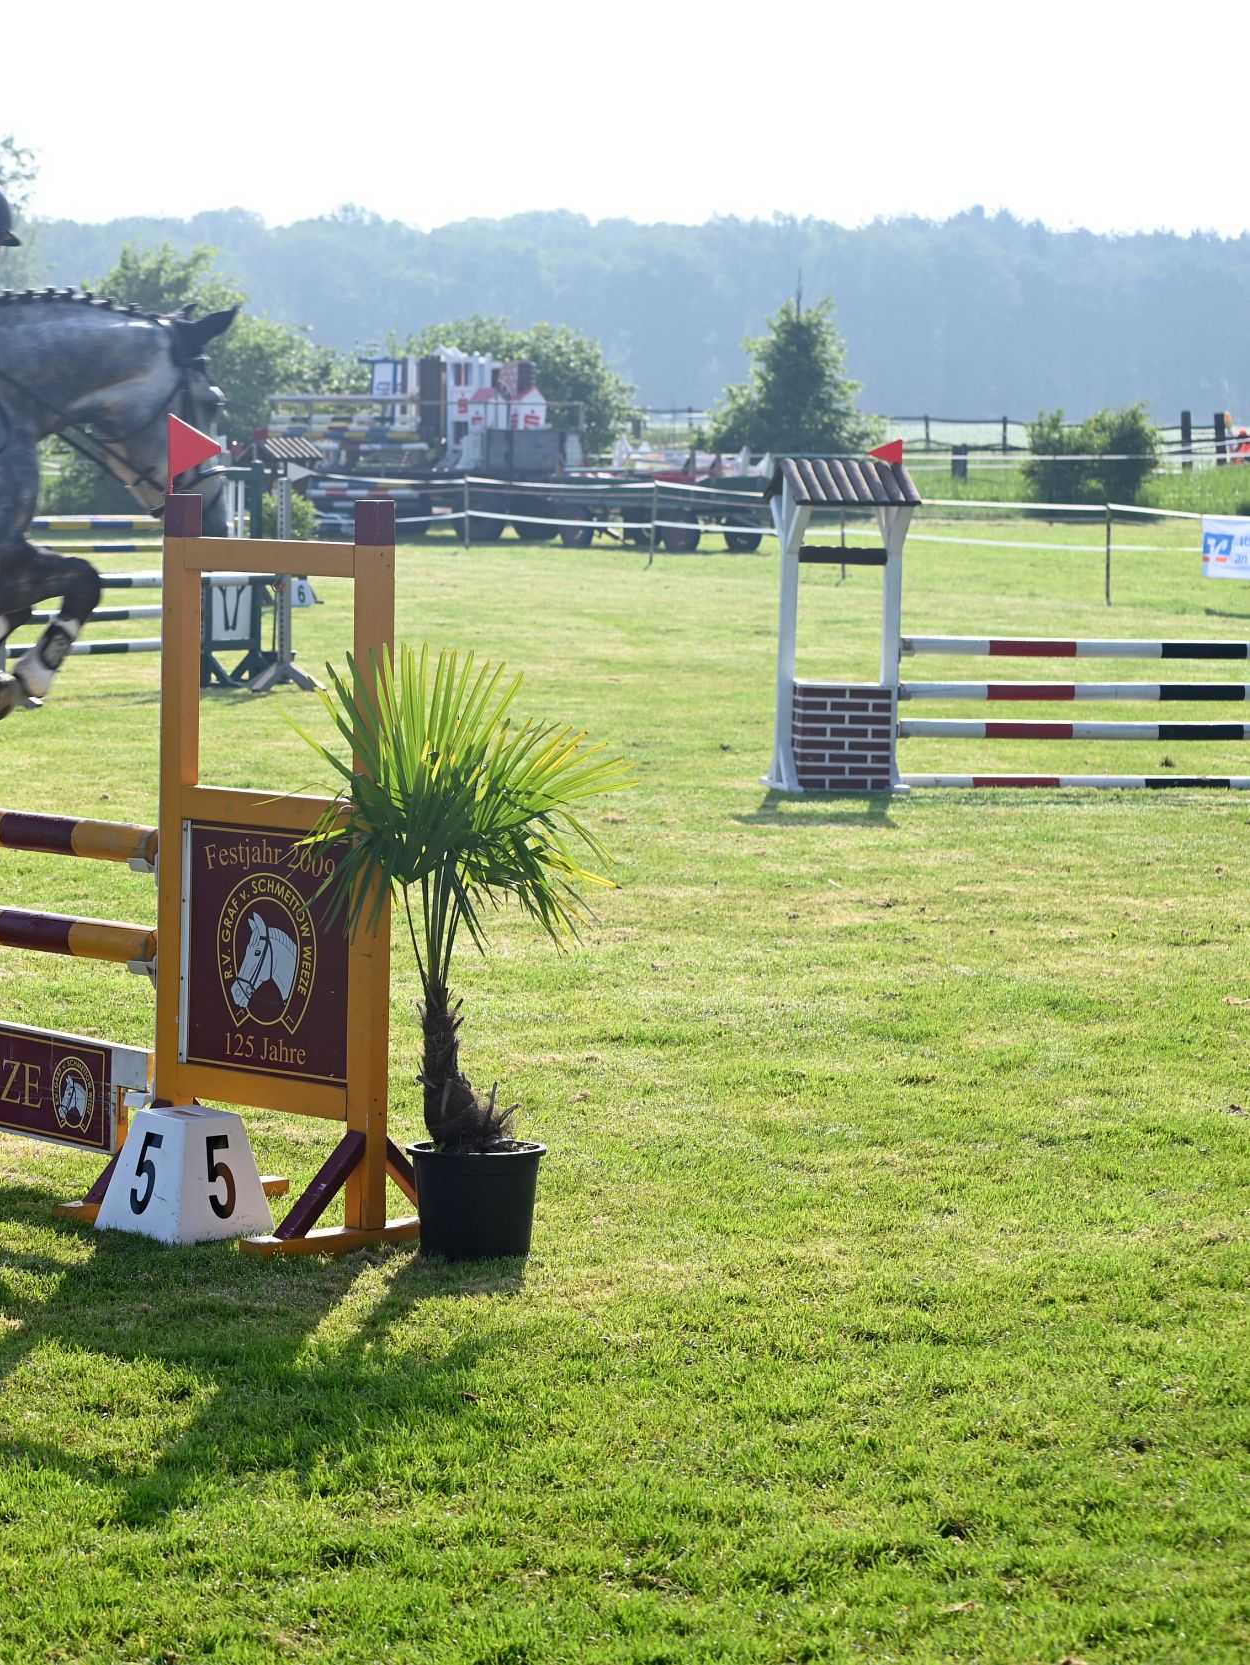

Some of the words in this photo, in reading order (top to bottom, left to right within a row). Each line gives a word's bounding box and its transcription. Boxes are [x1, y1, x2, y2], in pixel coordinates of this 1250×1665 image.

[203, 838, 283, 870] Festjahr
[221, 898, 239, 943] GRAF
[251, 878, 311, 937] SCHMETTOW
[222, 949, 233, 980] R.V.
[297, 945, 312, 996] WEEZE
[224, 1032, 254, 1058] 125
[260, 1037, 307, 1065] Jahre
[130, 1131, 164, 1215] 5
[206, 1134, 236, 1219] 5
